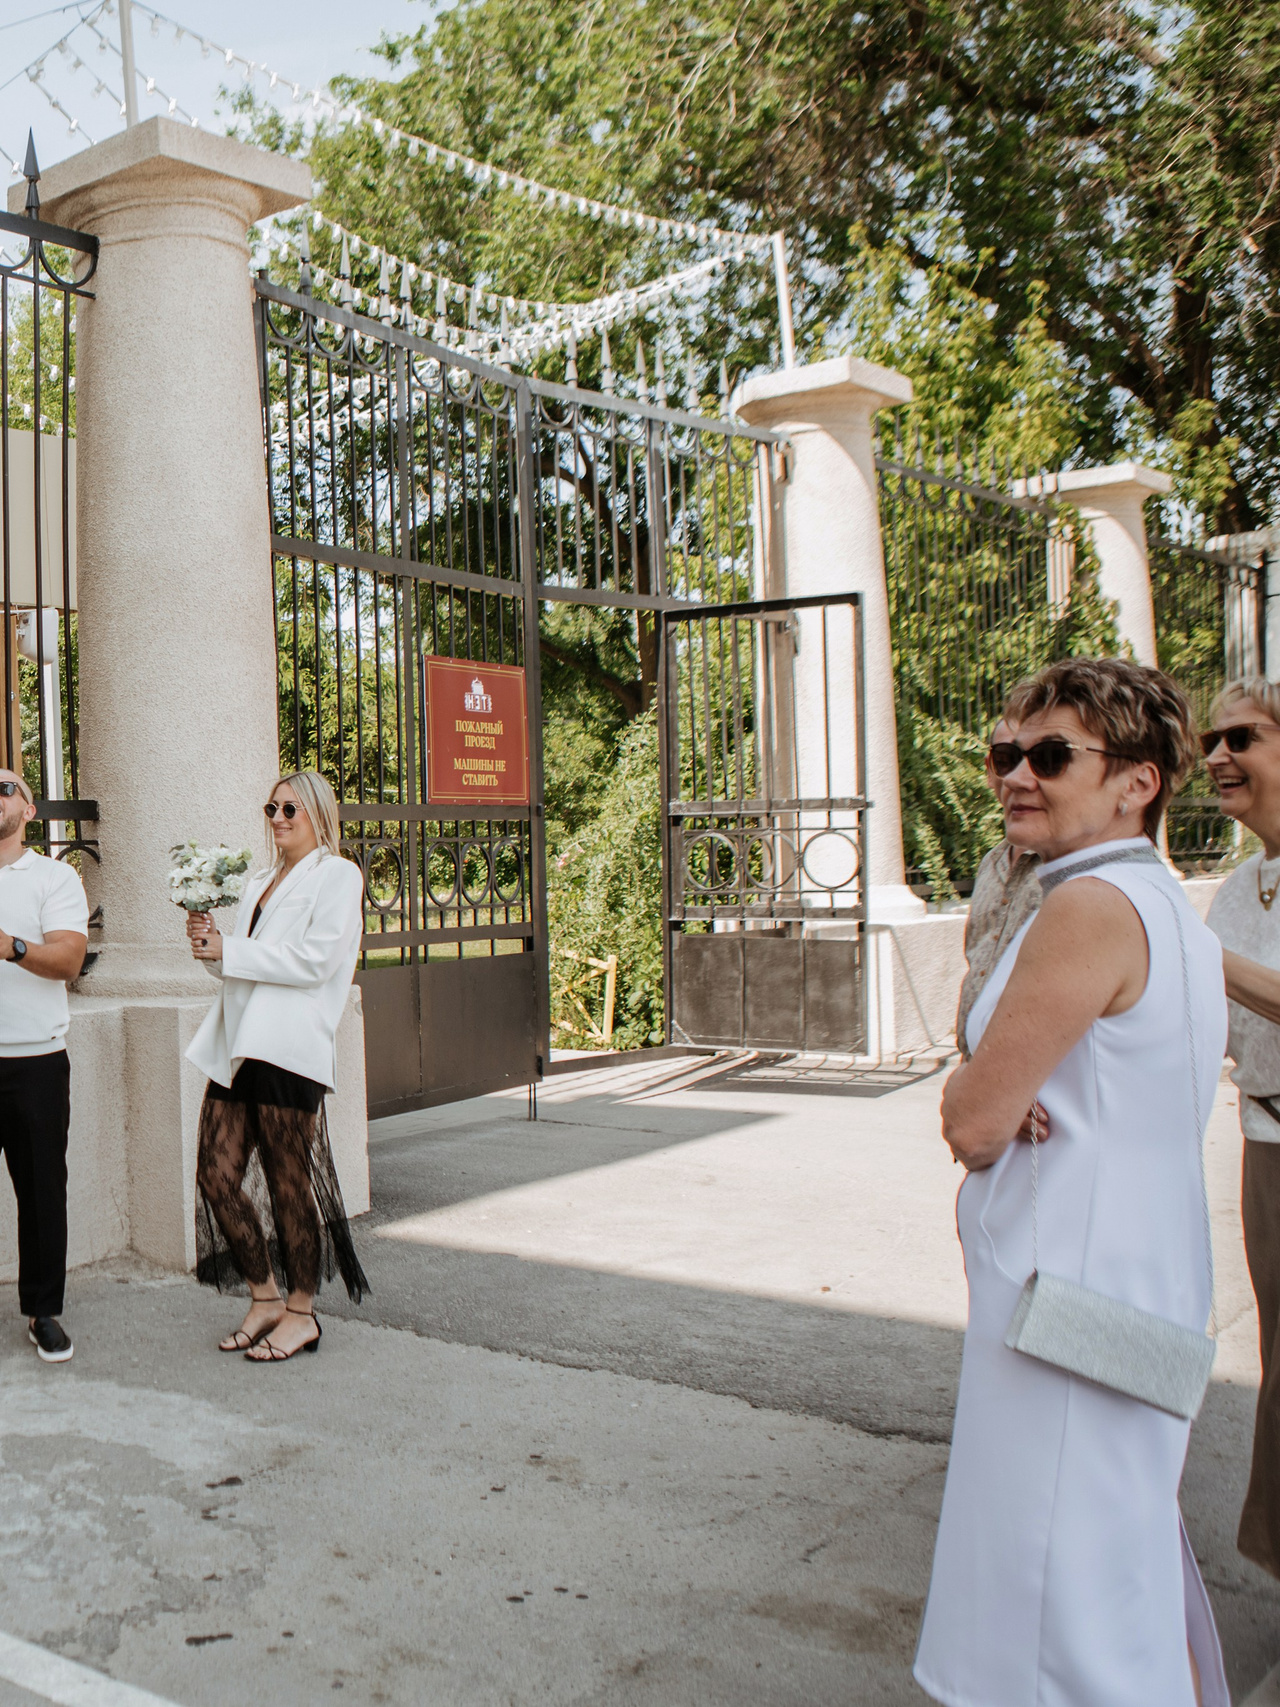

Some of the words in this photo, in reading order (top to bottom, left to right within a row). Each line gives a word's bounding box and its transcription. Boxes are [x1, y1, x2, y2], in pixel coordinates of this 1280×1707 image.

[455, 720, 503, 735] ПОЖАРНЫЙ
[465, 735, 496, 750] ПРОЕЗД
[454, 758, 493, 772] МАШИНЫ
[495, 760, 506, 772] НЕ
[462, 773, 499, 786] СТАВИТЬ
